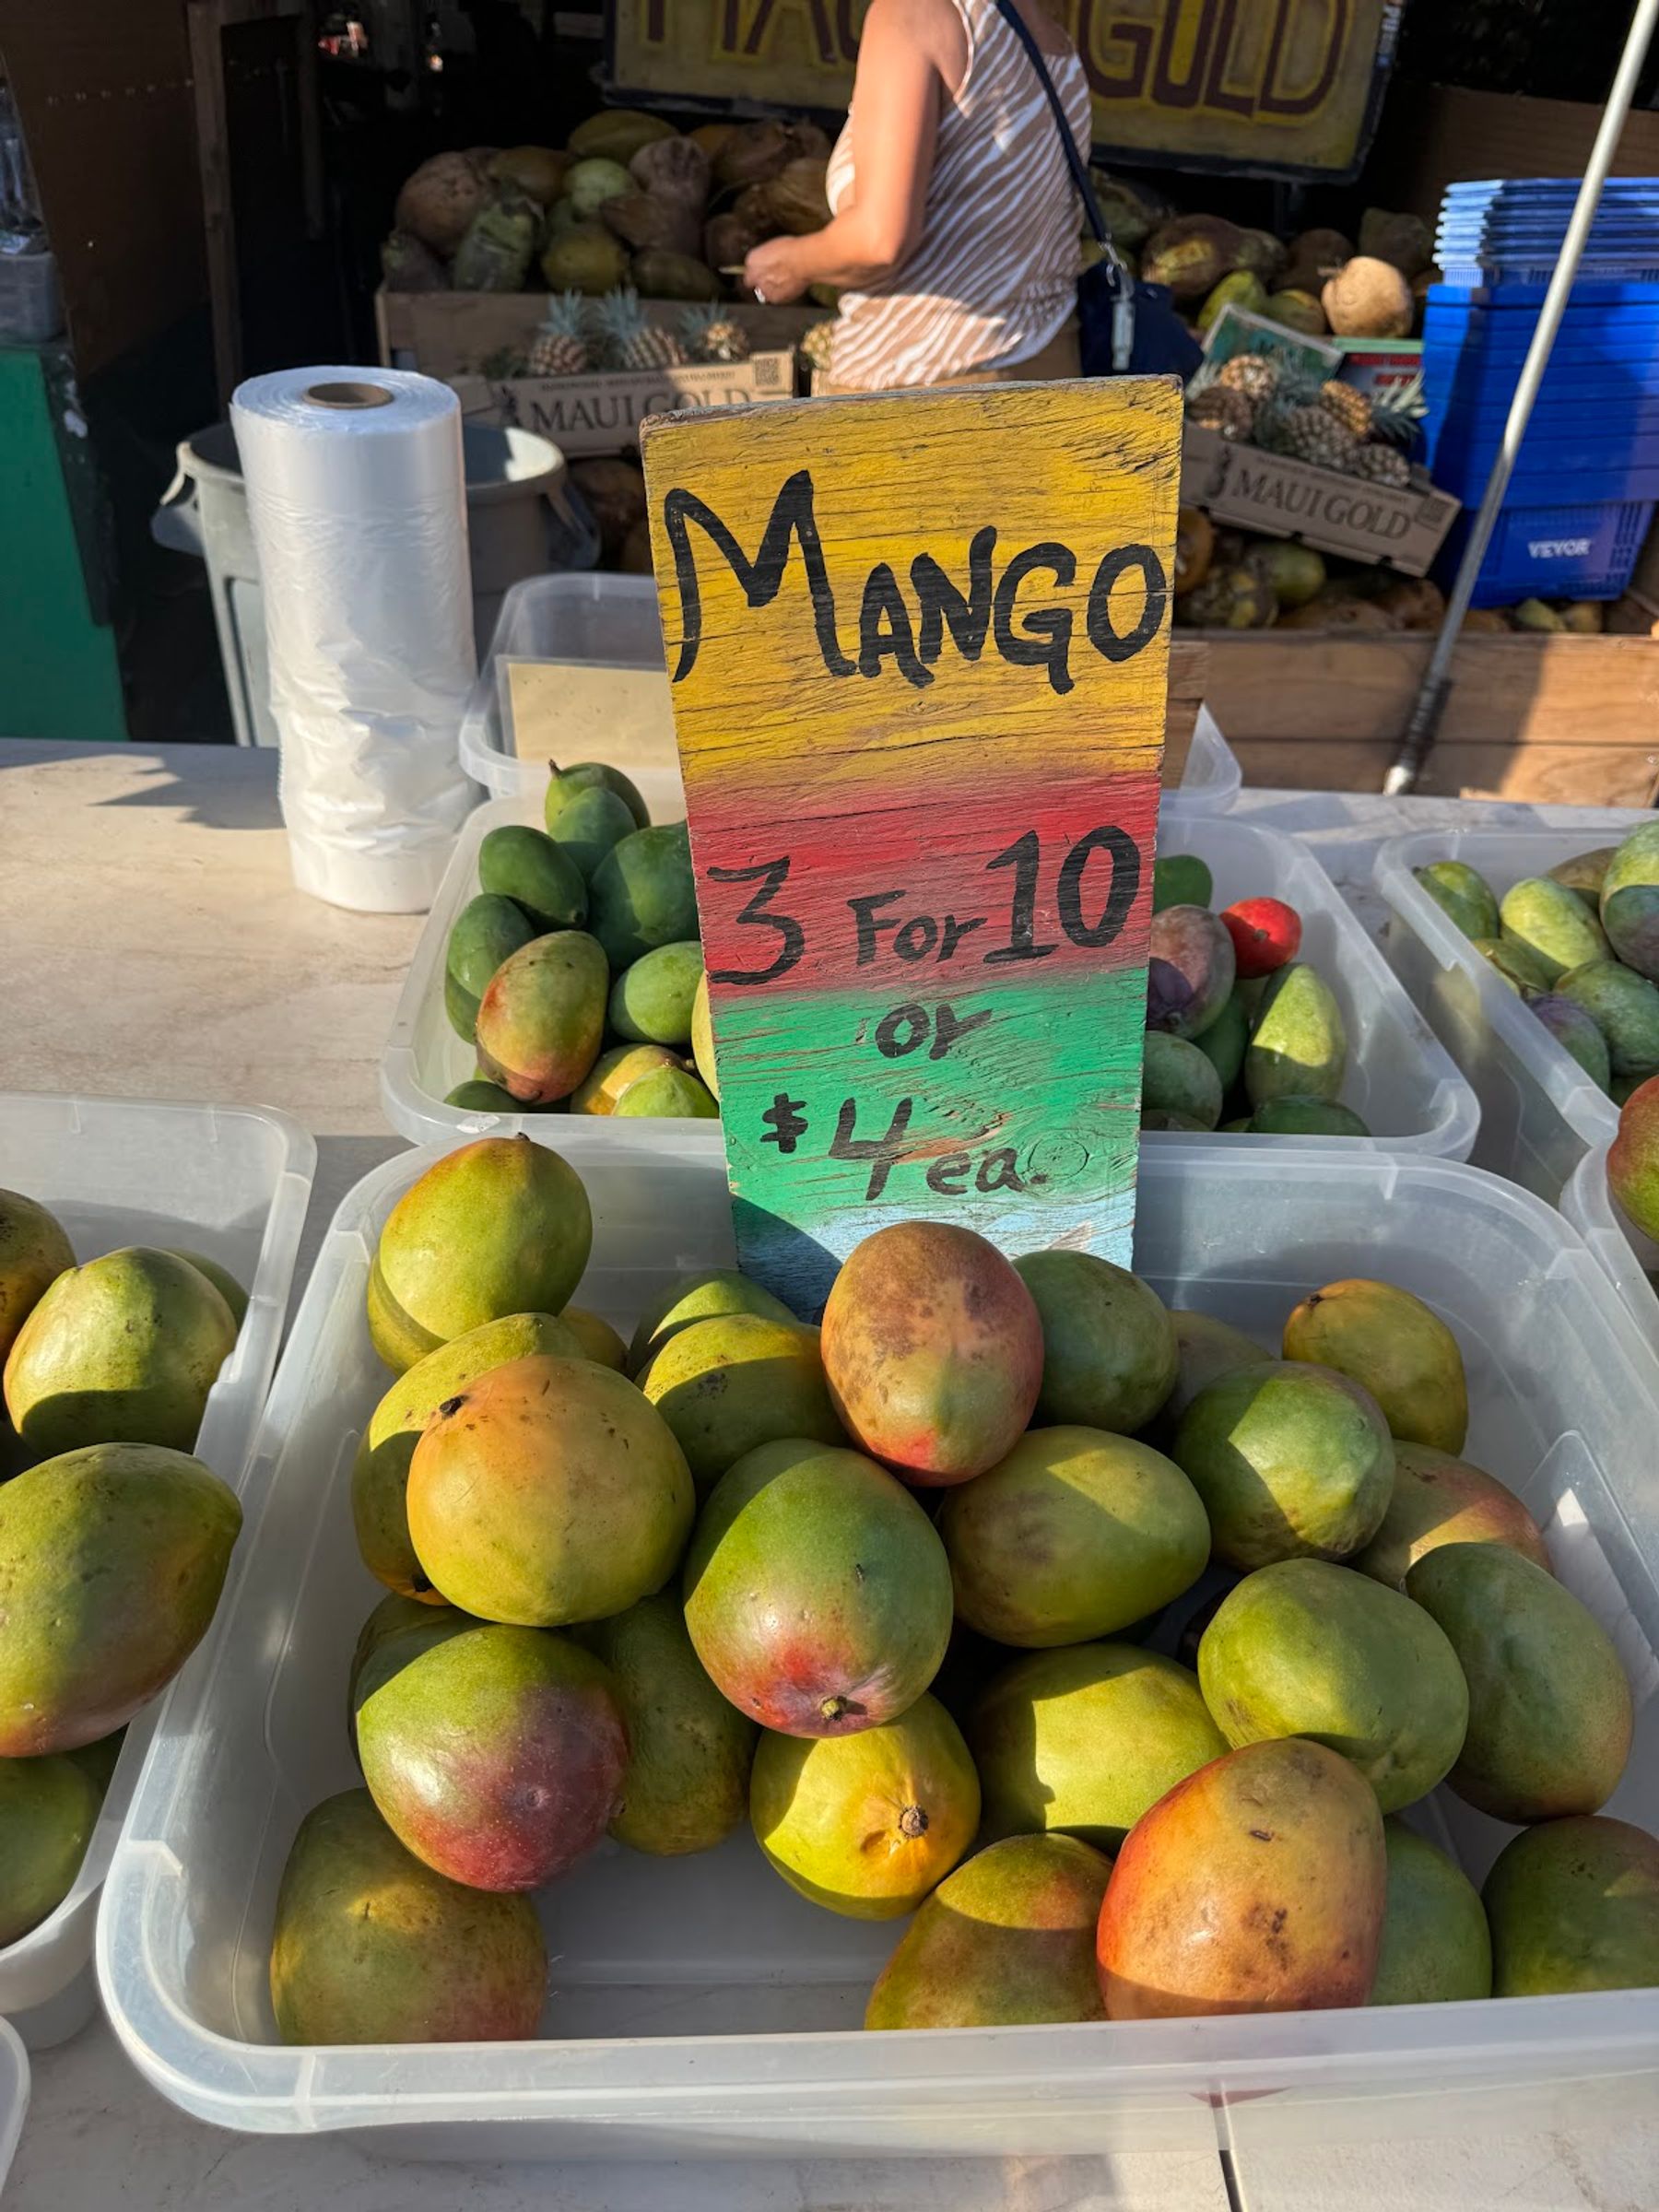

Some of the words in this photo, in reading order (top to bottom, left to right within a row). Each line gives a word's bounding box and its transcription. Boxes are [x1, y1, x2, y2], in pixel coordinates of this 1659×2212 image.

[530, 394, 635, 432] MAUI
[1231, 468, 1323, 518] MAUI
[1324, 493, 1412, 539] GOLD
[665, 470, 1166, 694] MANGO
[707, 857, 805, 984] 3
[847, 890, 988, 966] For
[983, 826, 1141, 964] 10
[876, 1003, 994, 1060] or
